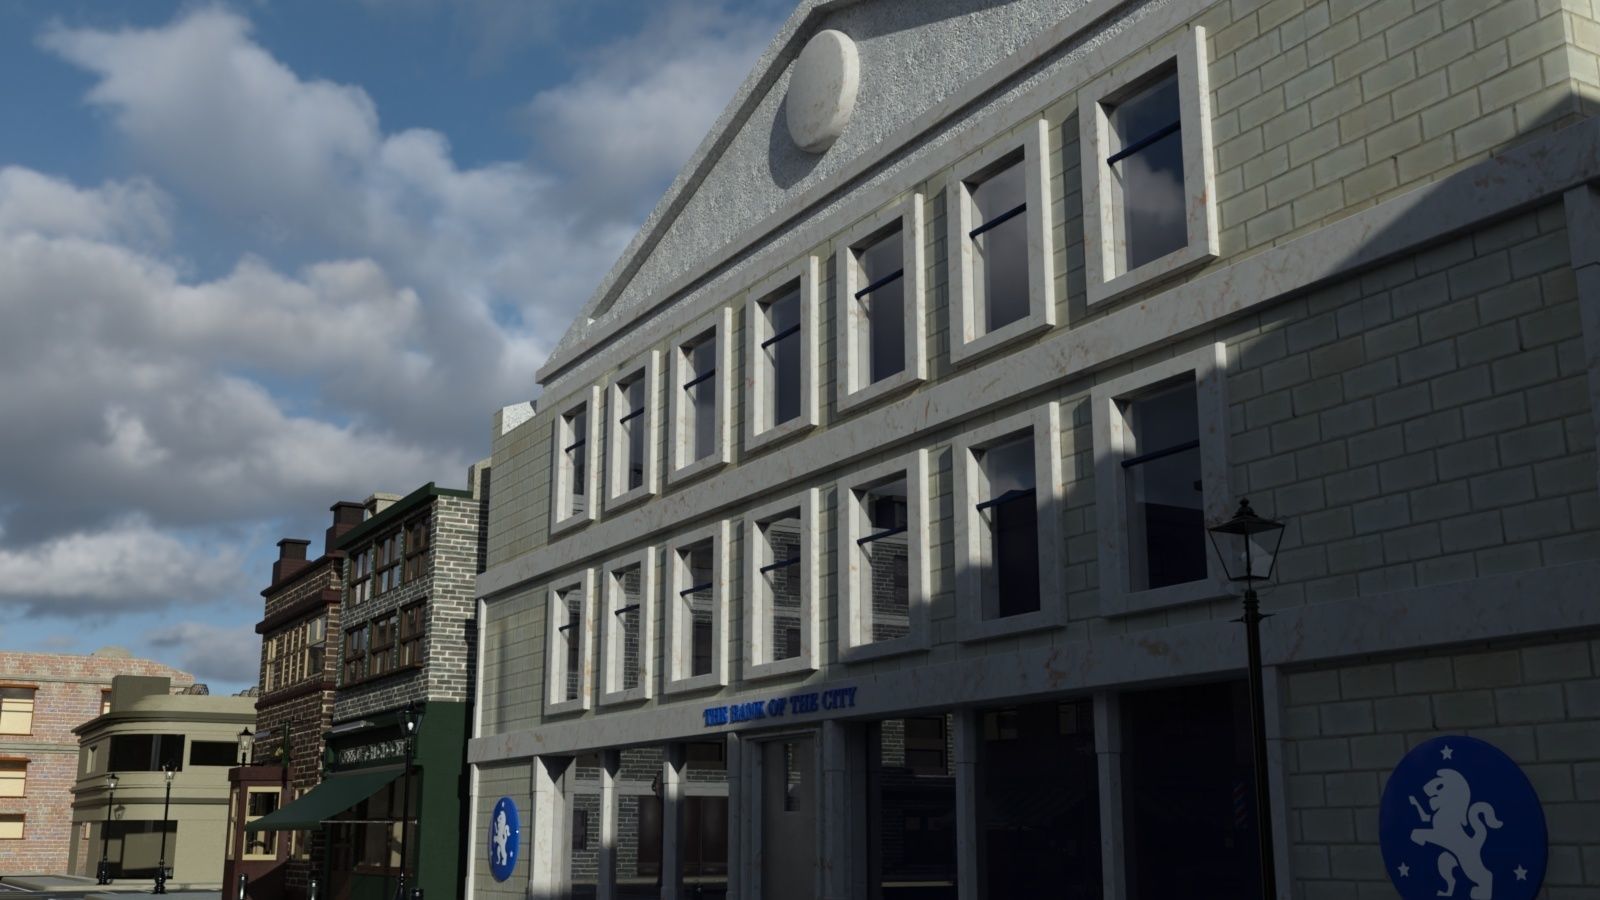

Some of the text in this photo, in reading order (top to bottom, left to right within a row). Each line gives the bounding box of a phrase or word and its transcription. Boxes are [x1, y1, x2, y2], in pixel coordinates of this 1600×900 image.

[703, 687, 857, 727] THE BANK OF THE CITY
